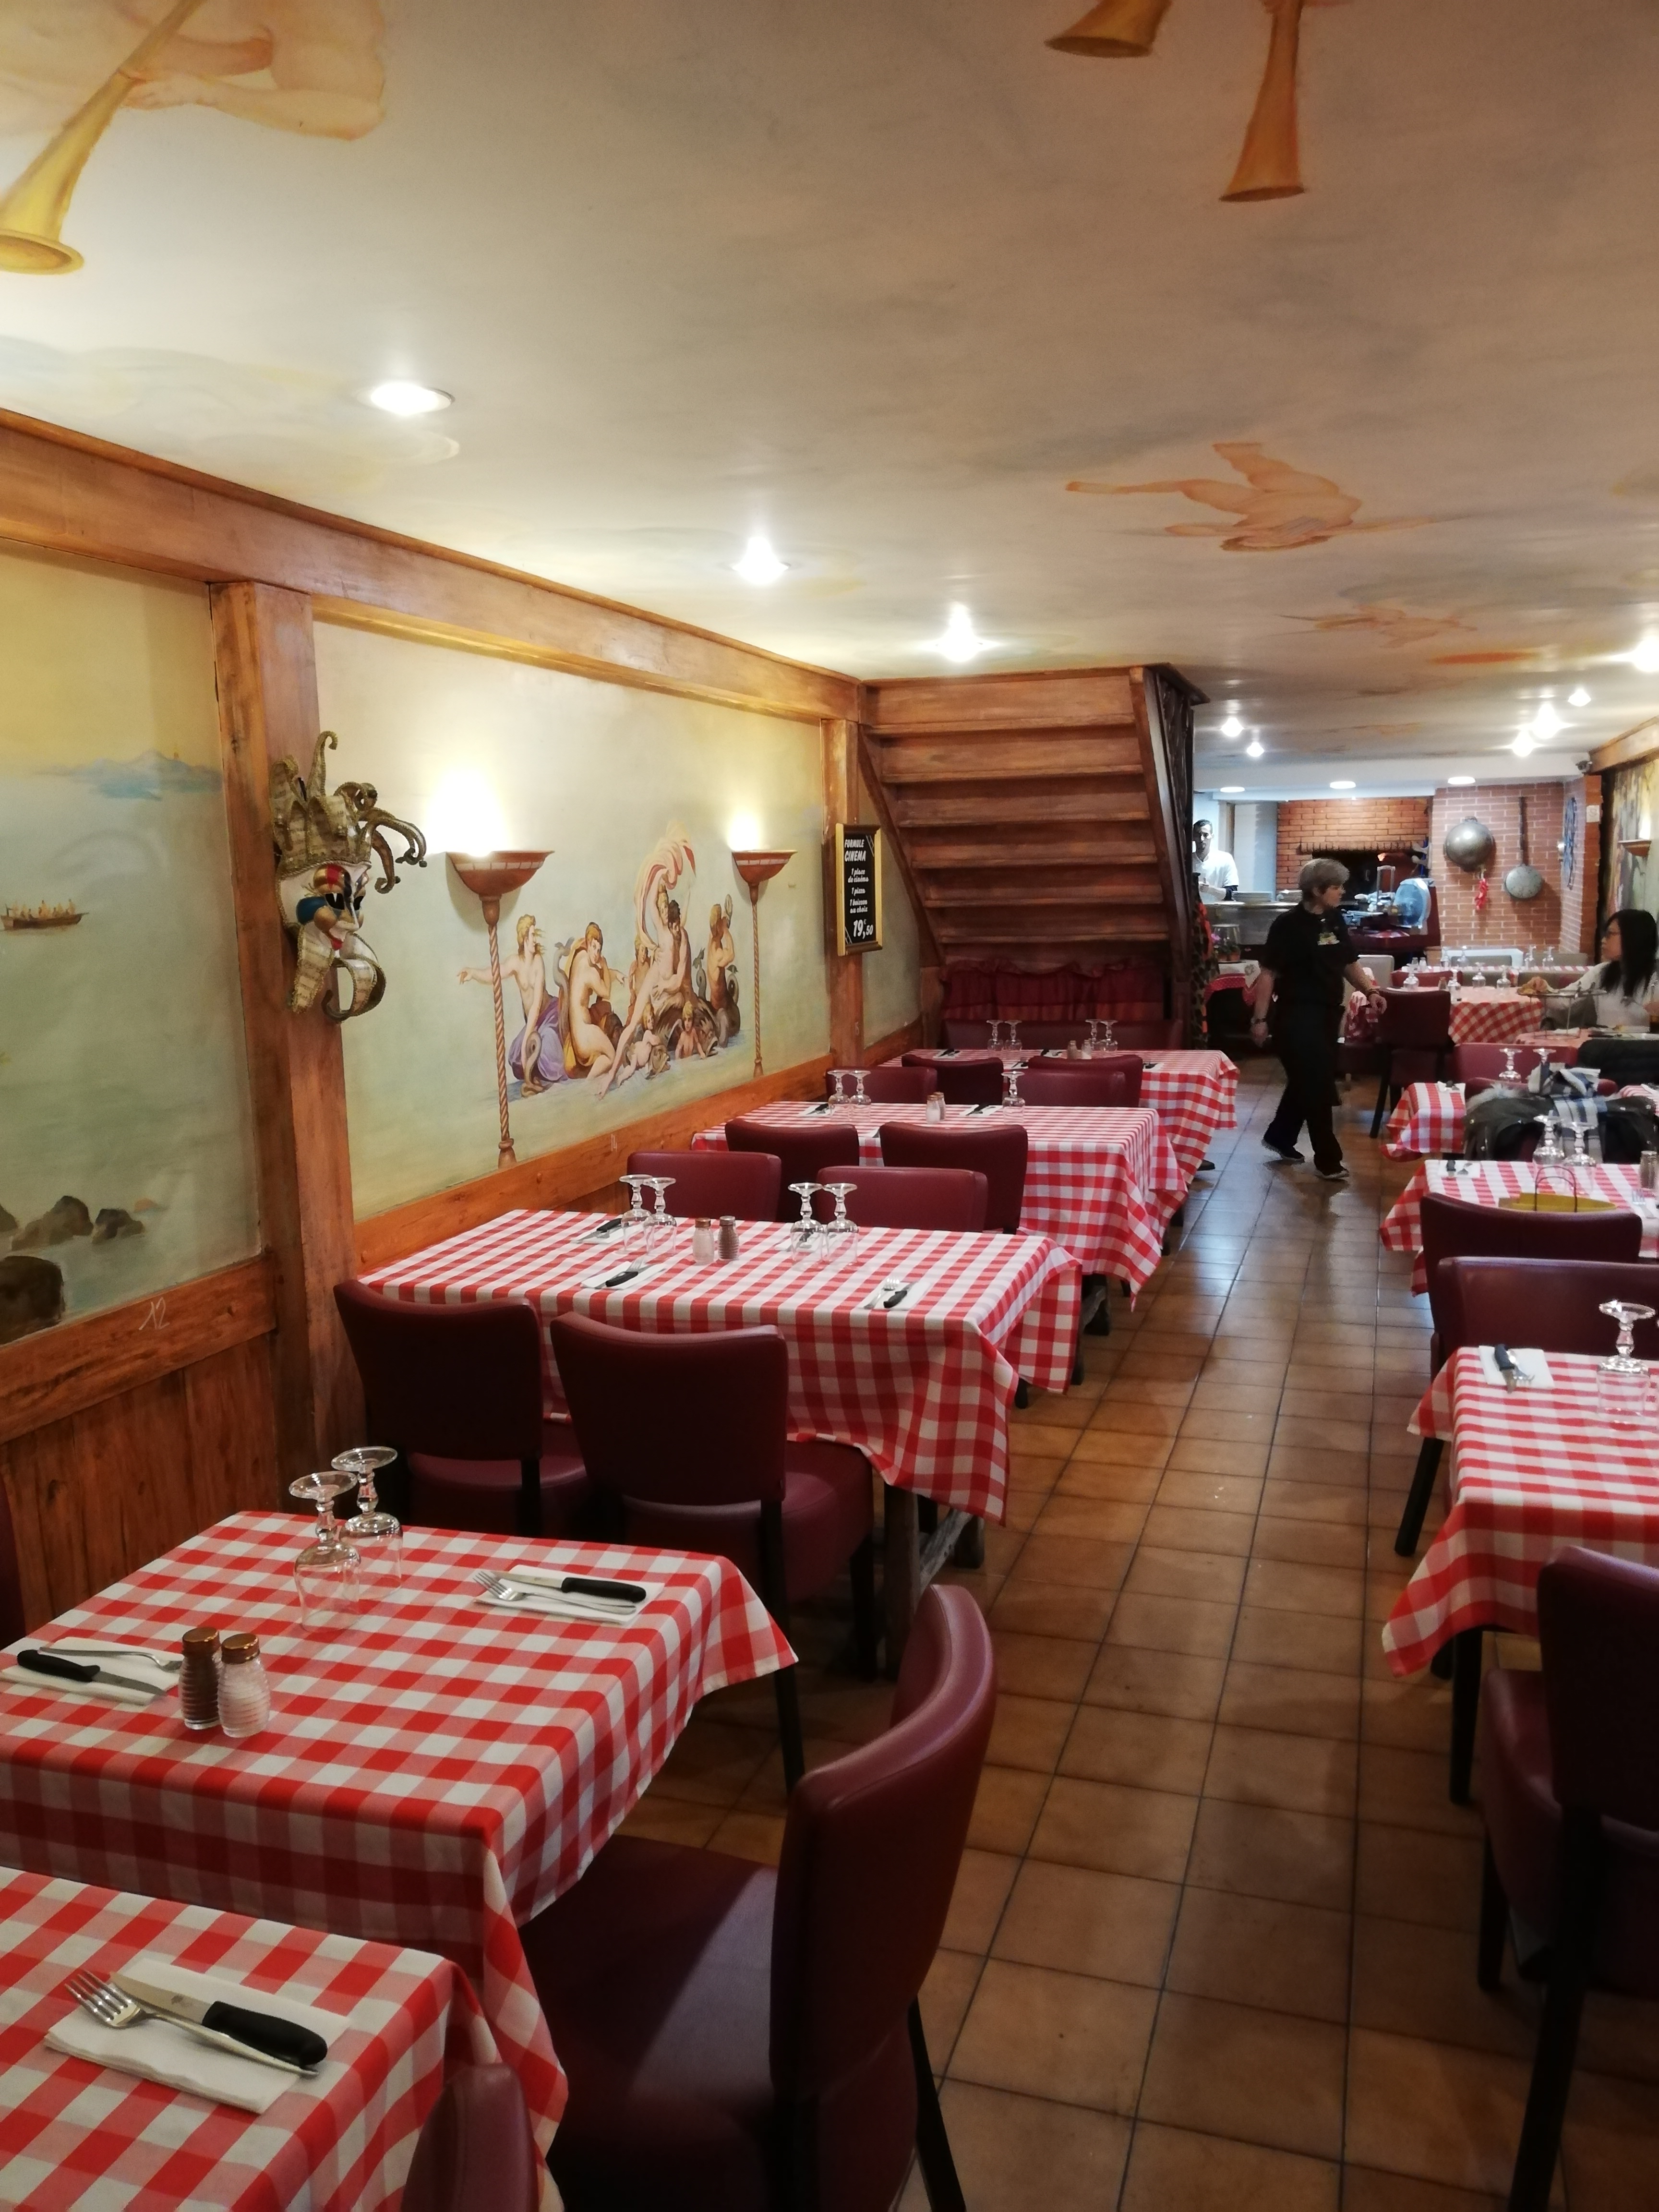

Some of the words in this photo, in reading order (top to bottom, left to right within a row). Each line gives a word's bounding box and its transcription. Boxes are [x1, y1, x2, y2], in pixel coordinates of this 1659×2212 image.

[844, 839, 865, 848] FORMULE
[844, 850, 866, 862] CINEMA
[854, 867, 865, 878] place
[854, 887, 866, 897] pizza
[138, 1297, 170, 1330] 12
